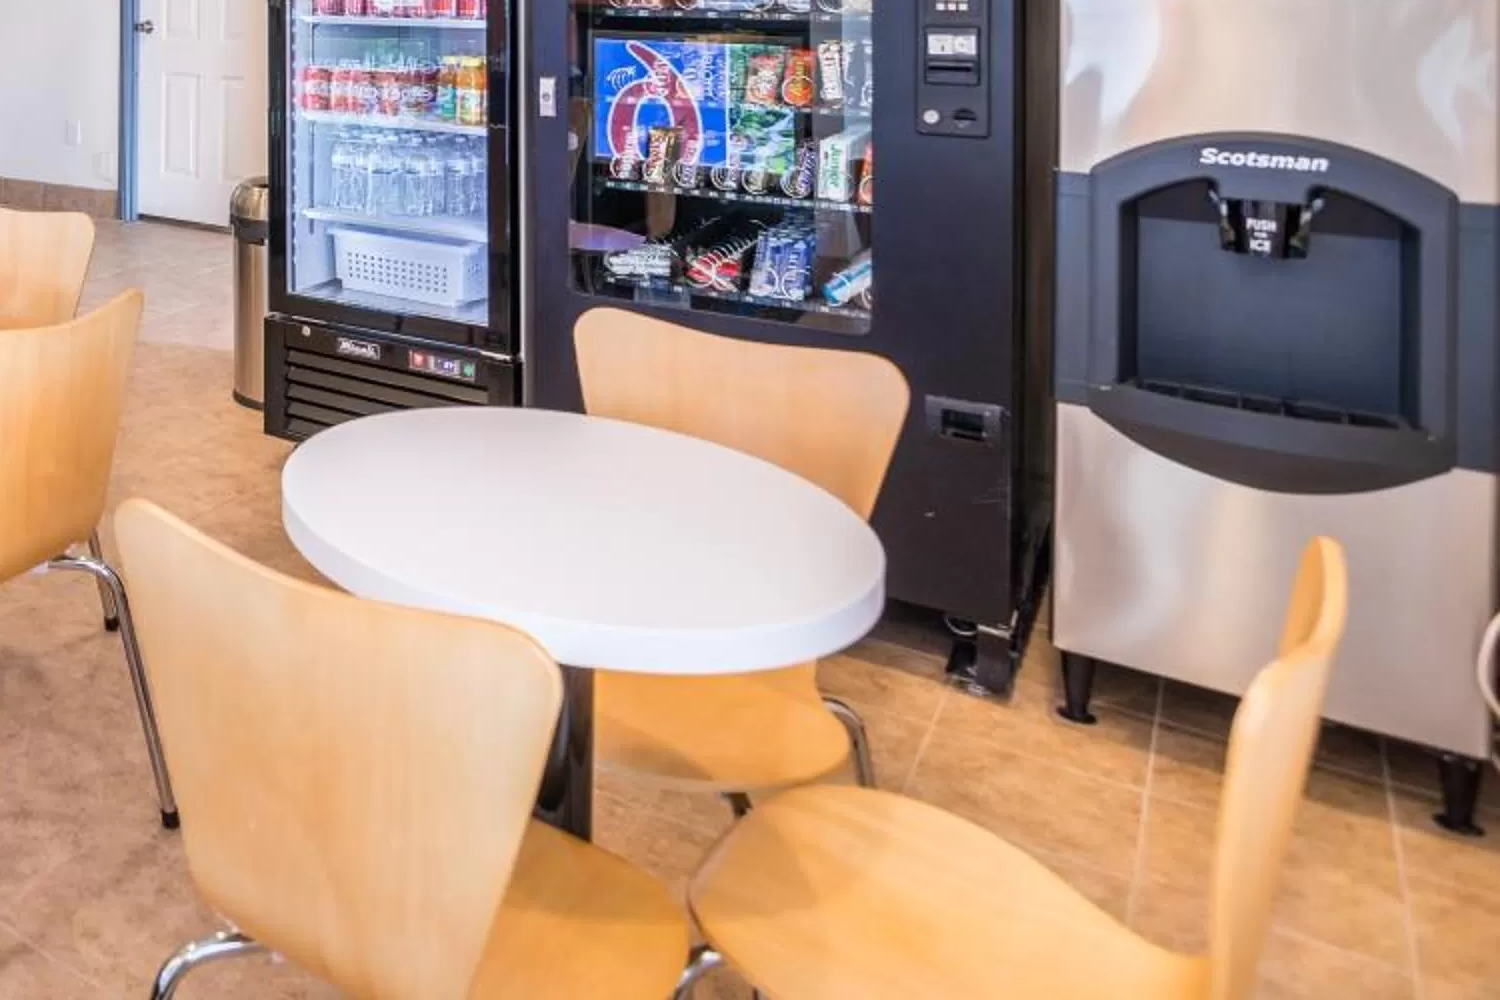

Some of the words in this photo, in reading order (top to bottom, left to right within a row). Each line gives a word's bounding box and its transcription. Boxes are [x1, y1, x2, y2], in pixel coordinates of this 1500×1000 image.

[1199, 146, 1330, 173] Scotsman
[1246, 217, 1277, 232] PUSH
[1250, 239, 1272, 253] ICE
